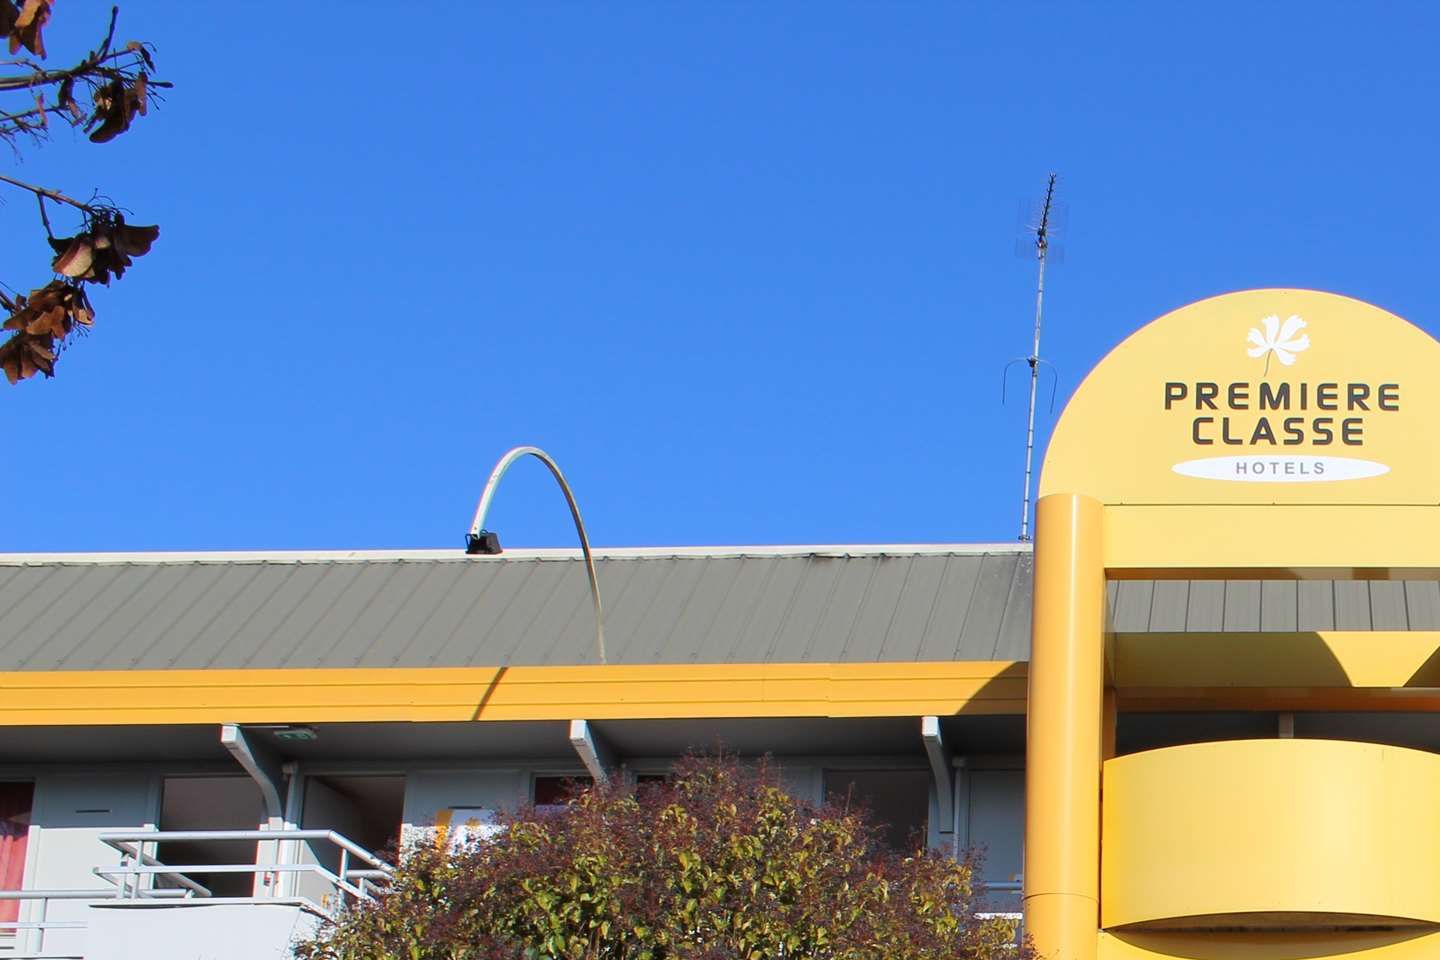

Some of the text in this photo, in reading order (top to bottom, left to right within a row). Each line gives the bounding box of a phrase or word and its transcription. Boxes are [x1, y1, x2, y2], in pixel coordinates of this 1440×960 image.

[1164, 382, 1400, 412] PREMIERE
[1192, 417, 1364, 445] CLASSE
[1235, 461, 1326, 475] HOTELS
